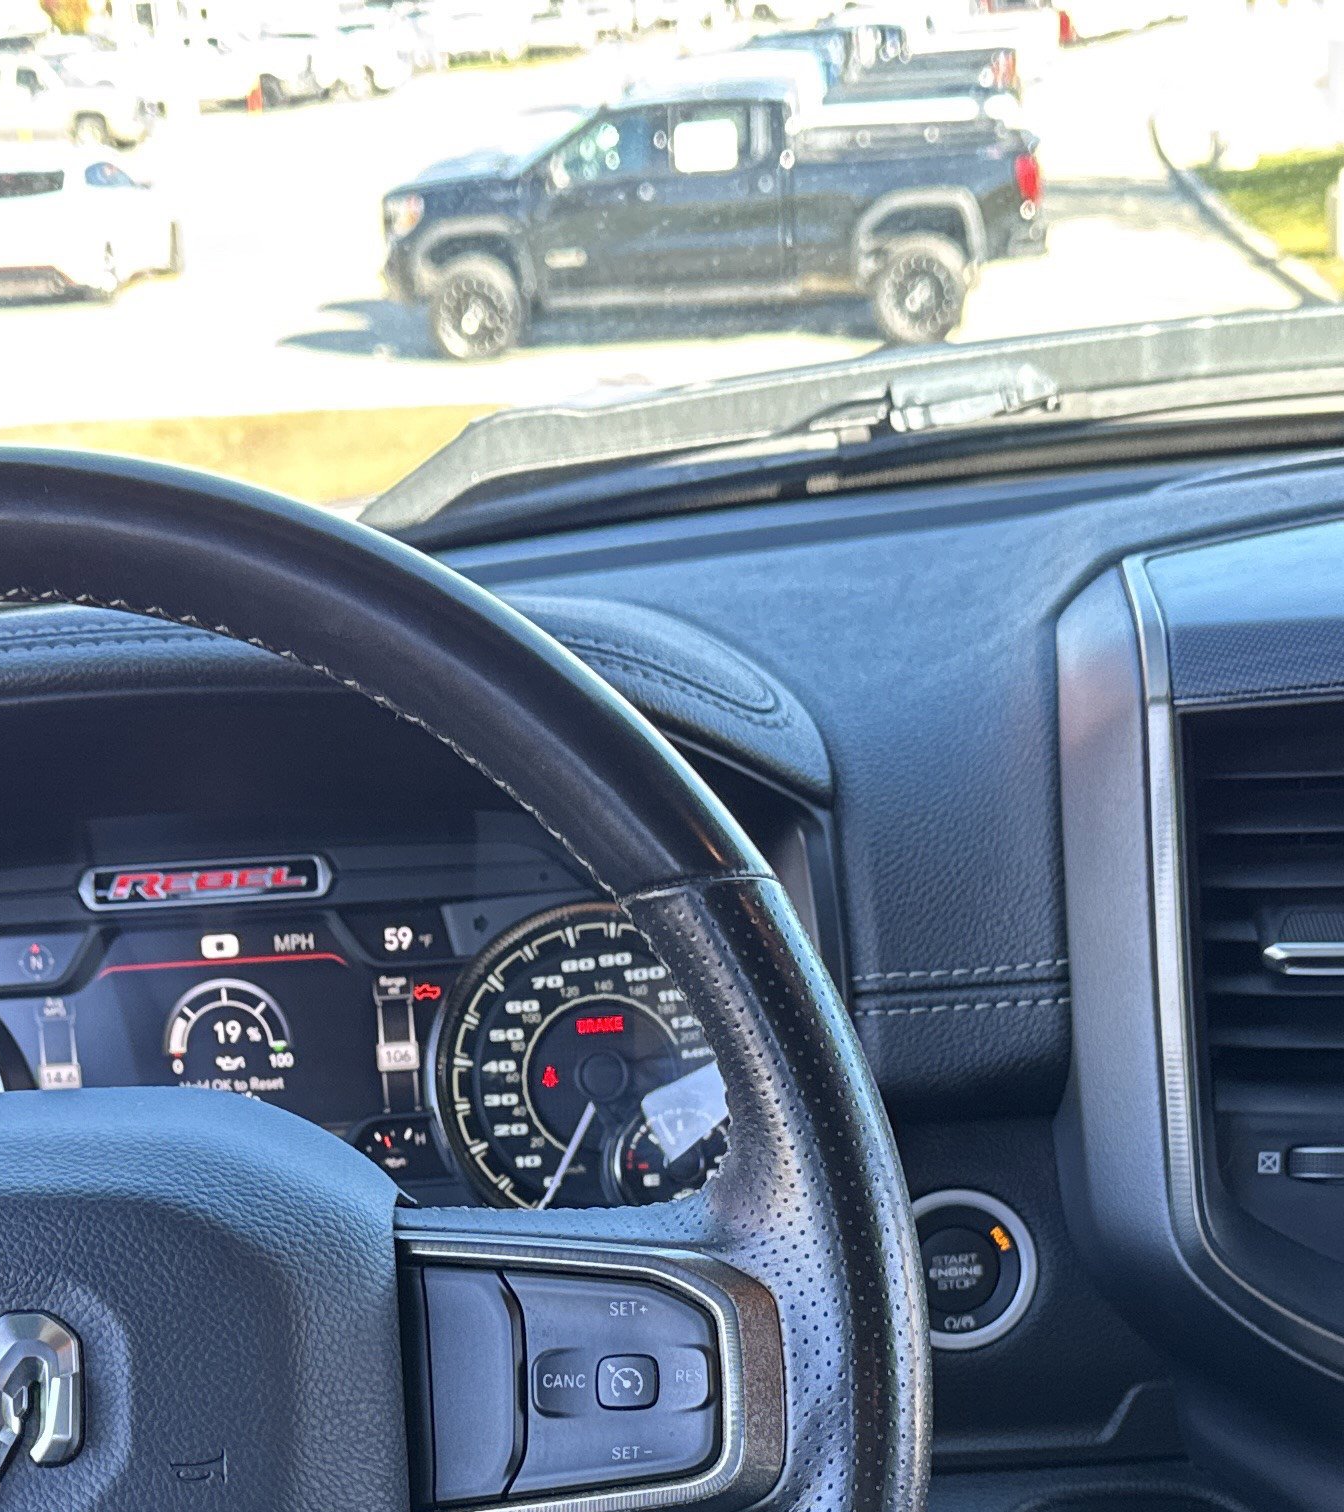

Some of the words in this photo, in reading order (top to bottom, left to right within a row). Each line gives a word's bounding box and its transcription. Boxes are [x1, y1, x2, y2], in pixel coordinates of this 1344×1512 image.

[108, 866, 307, 900] REBEL
[273, 933, 315, 952] MPH
[383, 926, 413, 951] 59
[623, 965, 666, 983] 100
[531, 975, 564, 990] 70
[214, 1019, 243, 1045] 19
[576, 1016, 624, 1035] BRAKE
[489, 1027, 525, 1043] 50
[269, 1052, 295, 1069] 100
[385, 1050, 412, 1064] 106
[482, 1059, 517, 1073] 40
[211, 1079, 233, 1091] OK
[484, 1092, 519, 1107] 30
[494, 1122, 529, 1137] 20
[515, 1154, 542, 1169] 10
[931, 1252, 978, 1266] START
[929, 1265, 983, 1279] ENGINE
[937, 1278, 978, 1291] STOP
[542, 1371, 587, 1391] CANC
[675, 1368, 704, 1384] RES
[611, 1445, 640, 1460] SET
